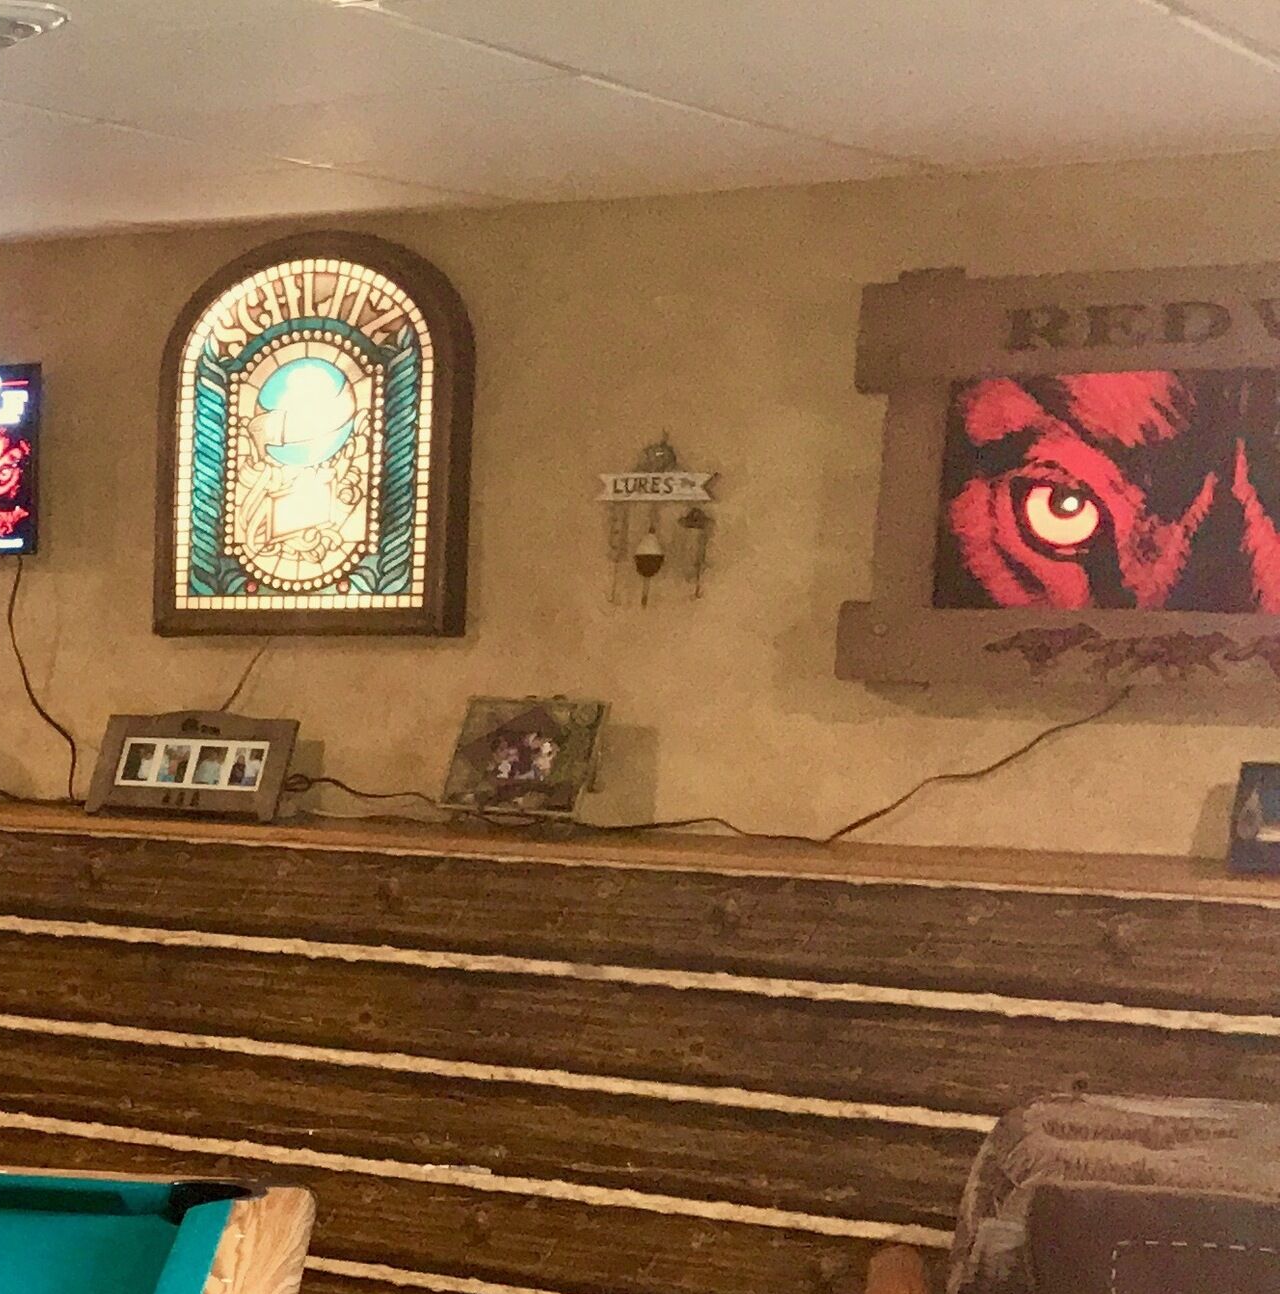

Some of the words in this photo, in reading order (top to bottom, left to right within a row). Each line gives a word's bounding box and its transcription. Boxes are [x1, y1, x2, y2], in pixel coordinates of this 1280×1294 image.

[212, 272, 405, 358] SCHLITZ
[1004, 300, 1233, 352] RED
[613, 476, 674, 495] LURES
